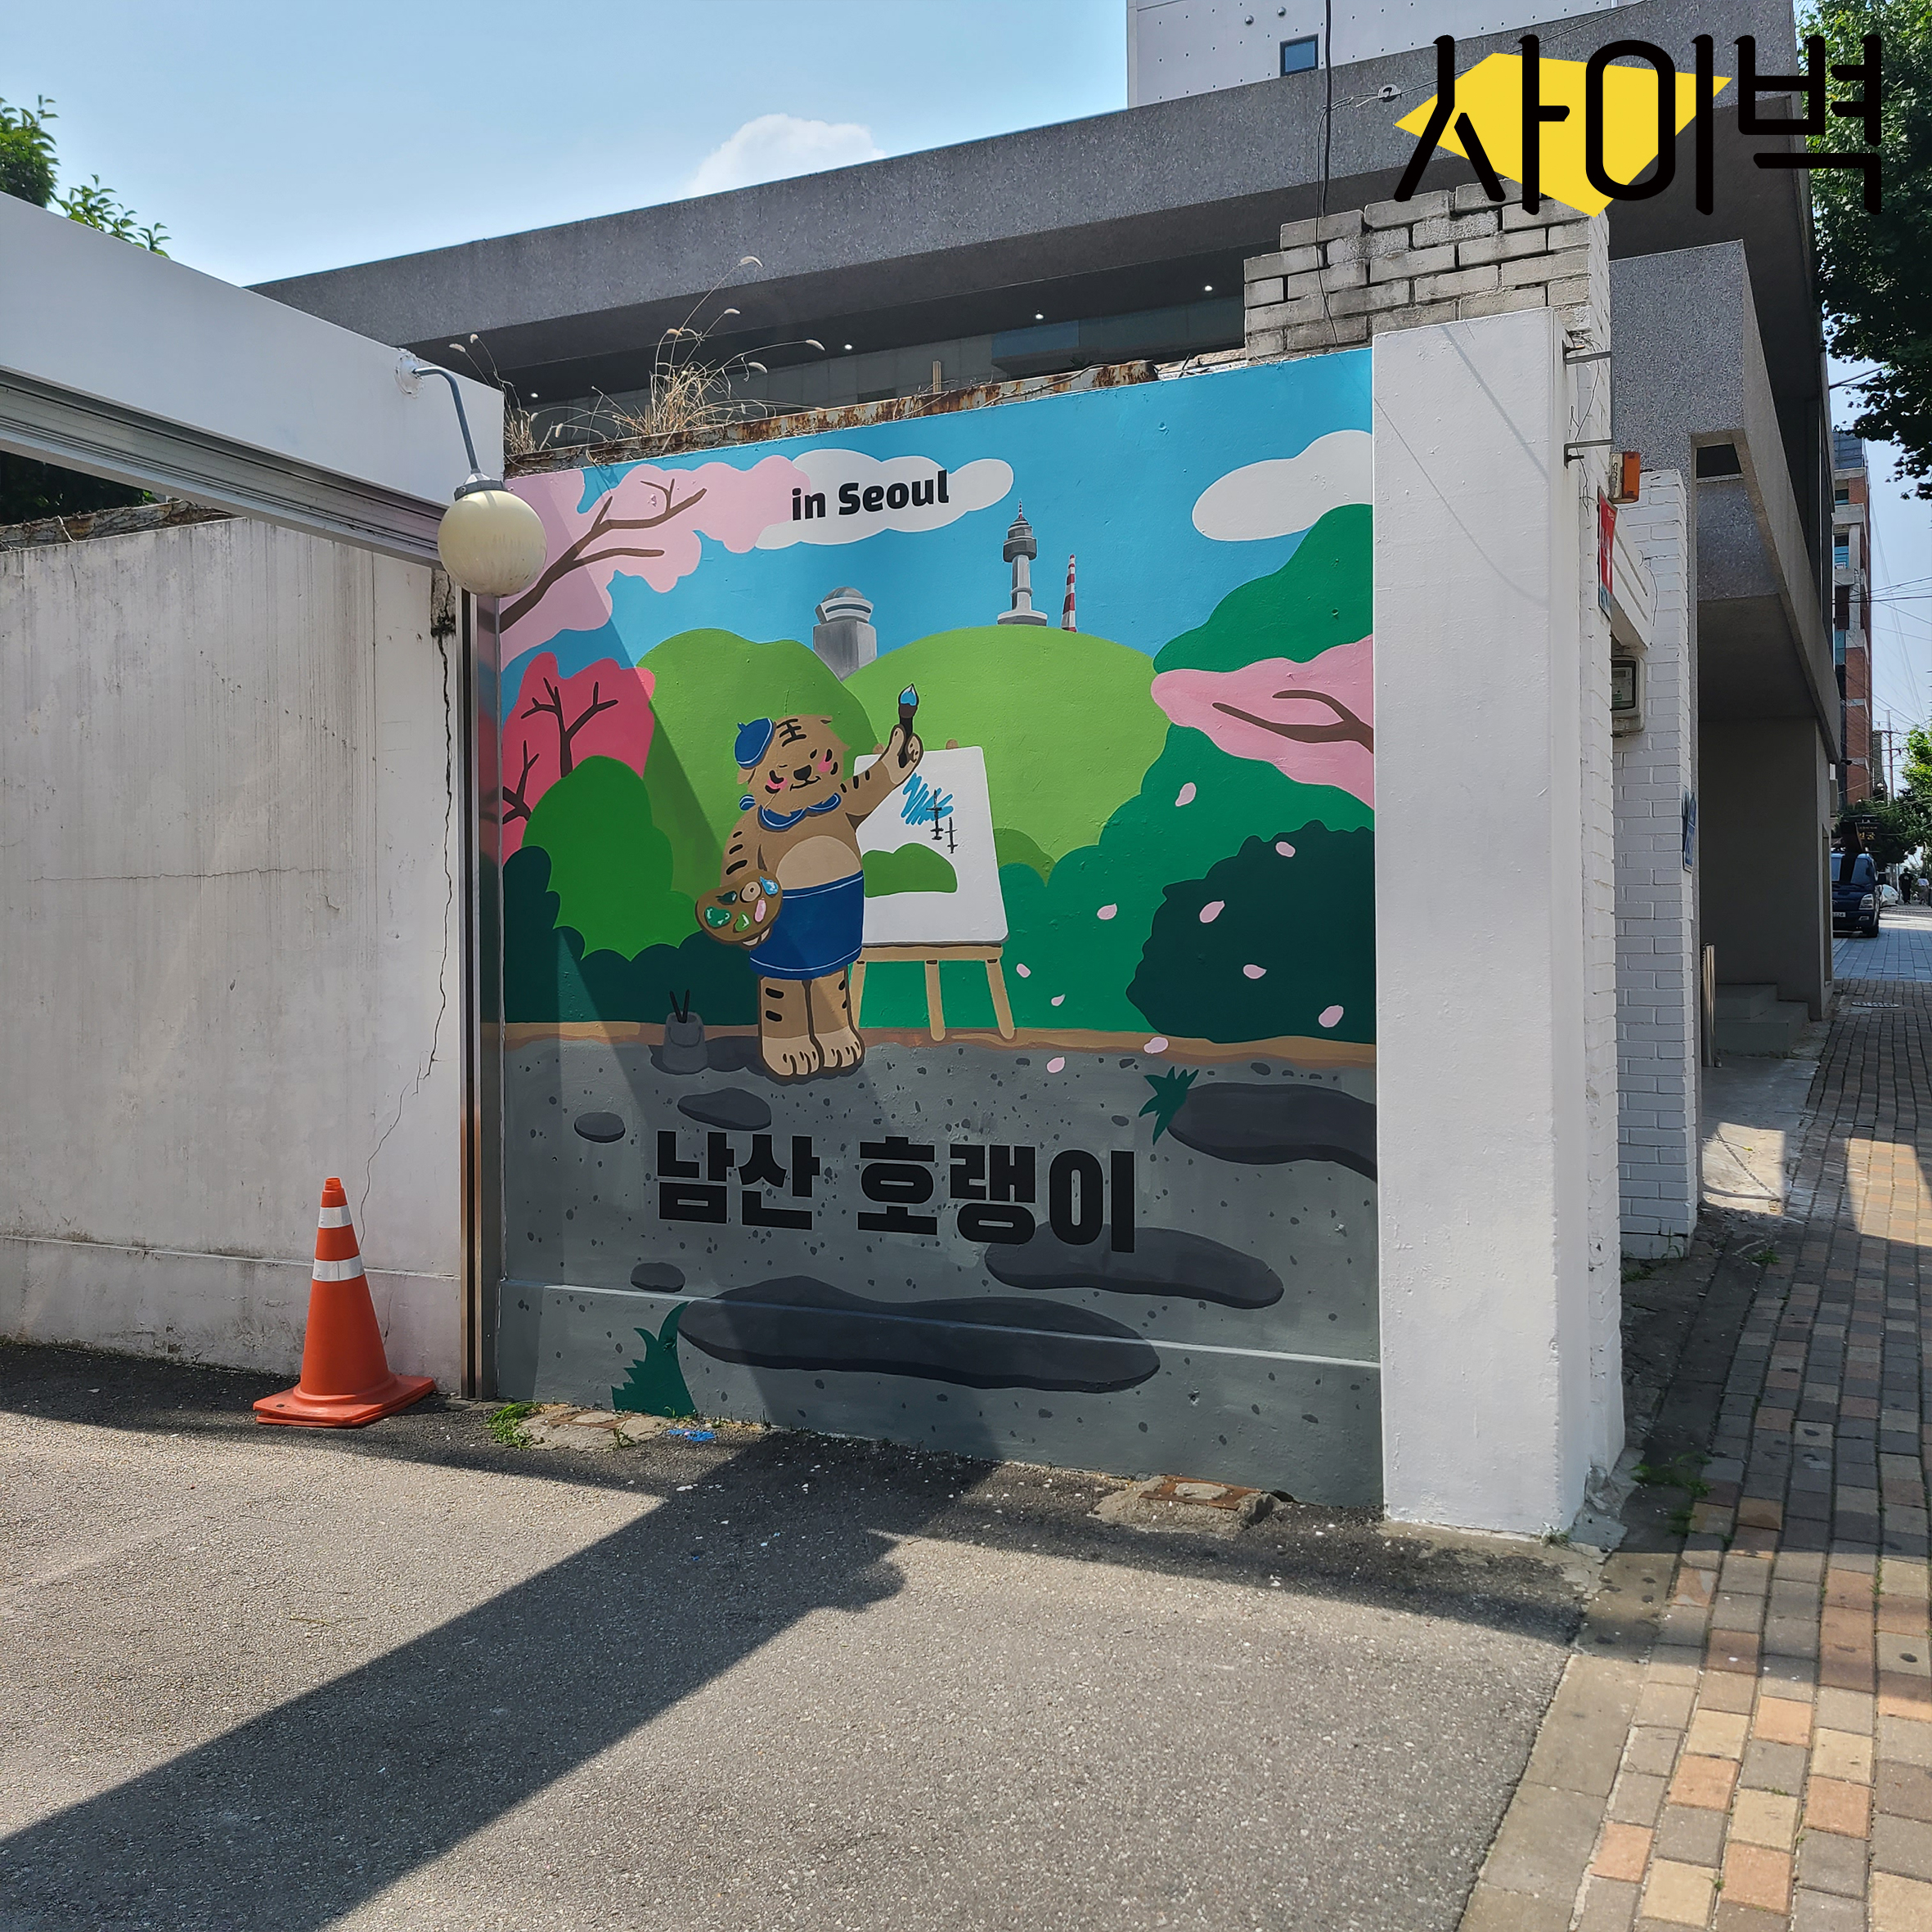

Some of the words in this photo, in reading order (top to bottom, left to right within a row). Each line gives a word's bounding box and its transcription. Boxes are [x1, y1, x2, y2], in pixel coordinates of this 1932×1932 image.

[791, 487, 827, 522] in
[838, 469, 950, 516] Seoul
[657, 1130, 820, 1231] 남산
[857, 1135, 1135, 1254] 호랭이
